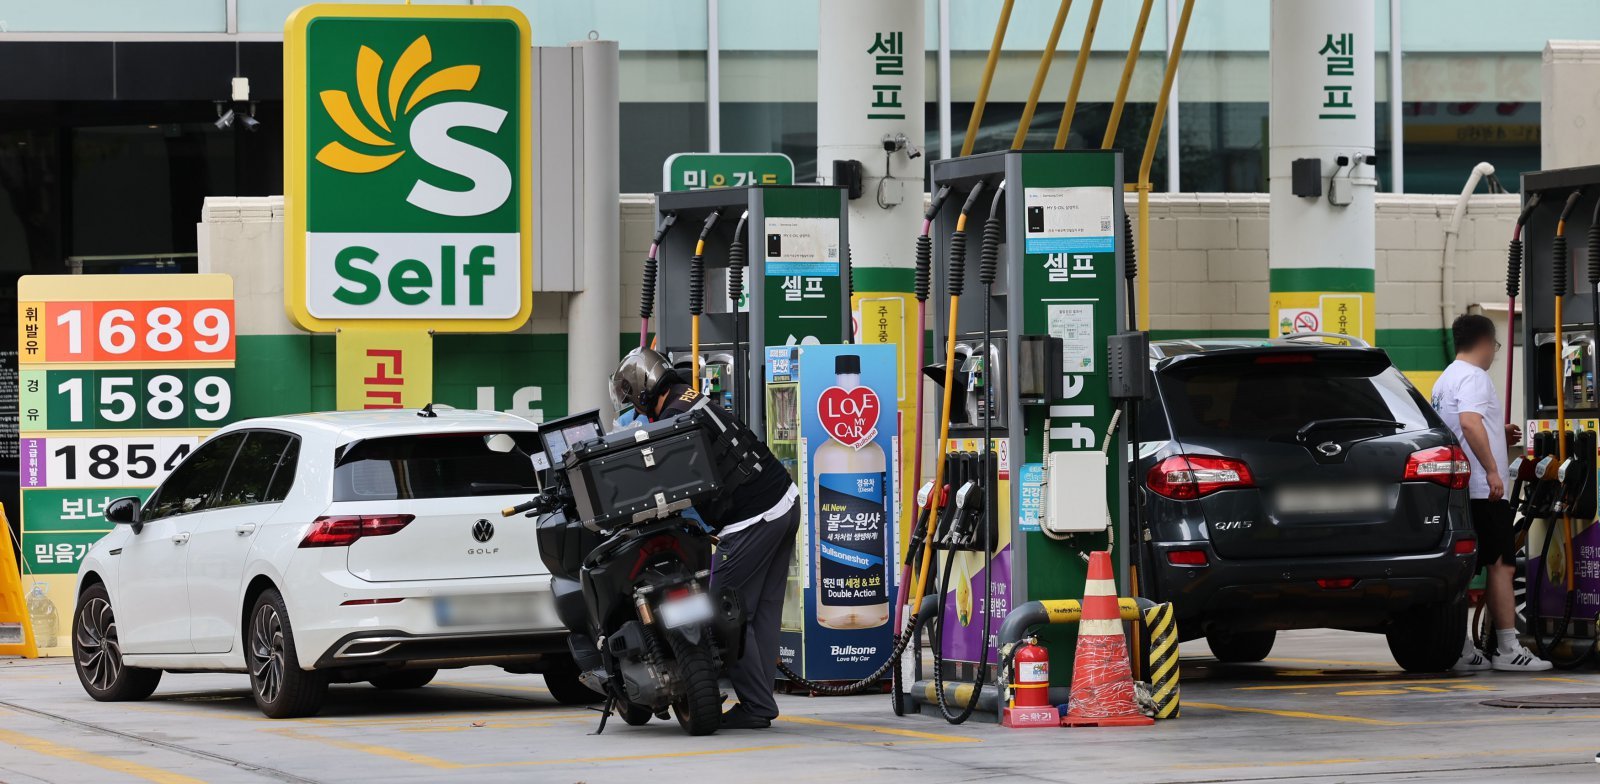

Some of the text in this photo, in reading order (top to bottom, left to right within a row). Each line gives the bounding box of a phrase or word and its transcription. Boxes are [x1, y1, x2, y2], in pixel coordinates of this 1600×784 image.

[866, 31, 906, 120] 셀프
[1318, 33, 1356, 119] 셀프
[332, 245, 495, 306] Self
[1043, 252, 1097, 282] 셀프
[781, 276, 826, 301] 셀프
[25, 307, 39, 355] 휘발유
[56, 307, 231, 355] 1689
[878, 306, 888, 343] 주유중
[57, 374, 232, 422] 1589
[828, 393, 876, 418] LOVE
[834, 422, 864, 438] CAR
[854, 418, 866, 426] MY
[856, 478, 875, 487] 경유차
[822, 503, 847, 512] All New
[826, 512, 881, 532] 불스원샷
[1215, 520, 1253, 531] QM5
[1423, 515, 1441, 524] LE
[467, 547, 499, 555] GOLF
[821, 543, 870, 566] Bullsoneshot
[845, 577, 860, 589] 세정
[861, 578, 868, 587] &
[868, 576, 880, 587] 보호
[828, 588, 877, 598] Double Action
[830, 645, 877, 656] Bullsone
[851, 655, 859, 663] My
[1020, 711, 1052, 720] 소화기
